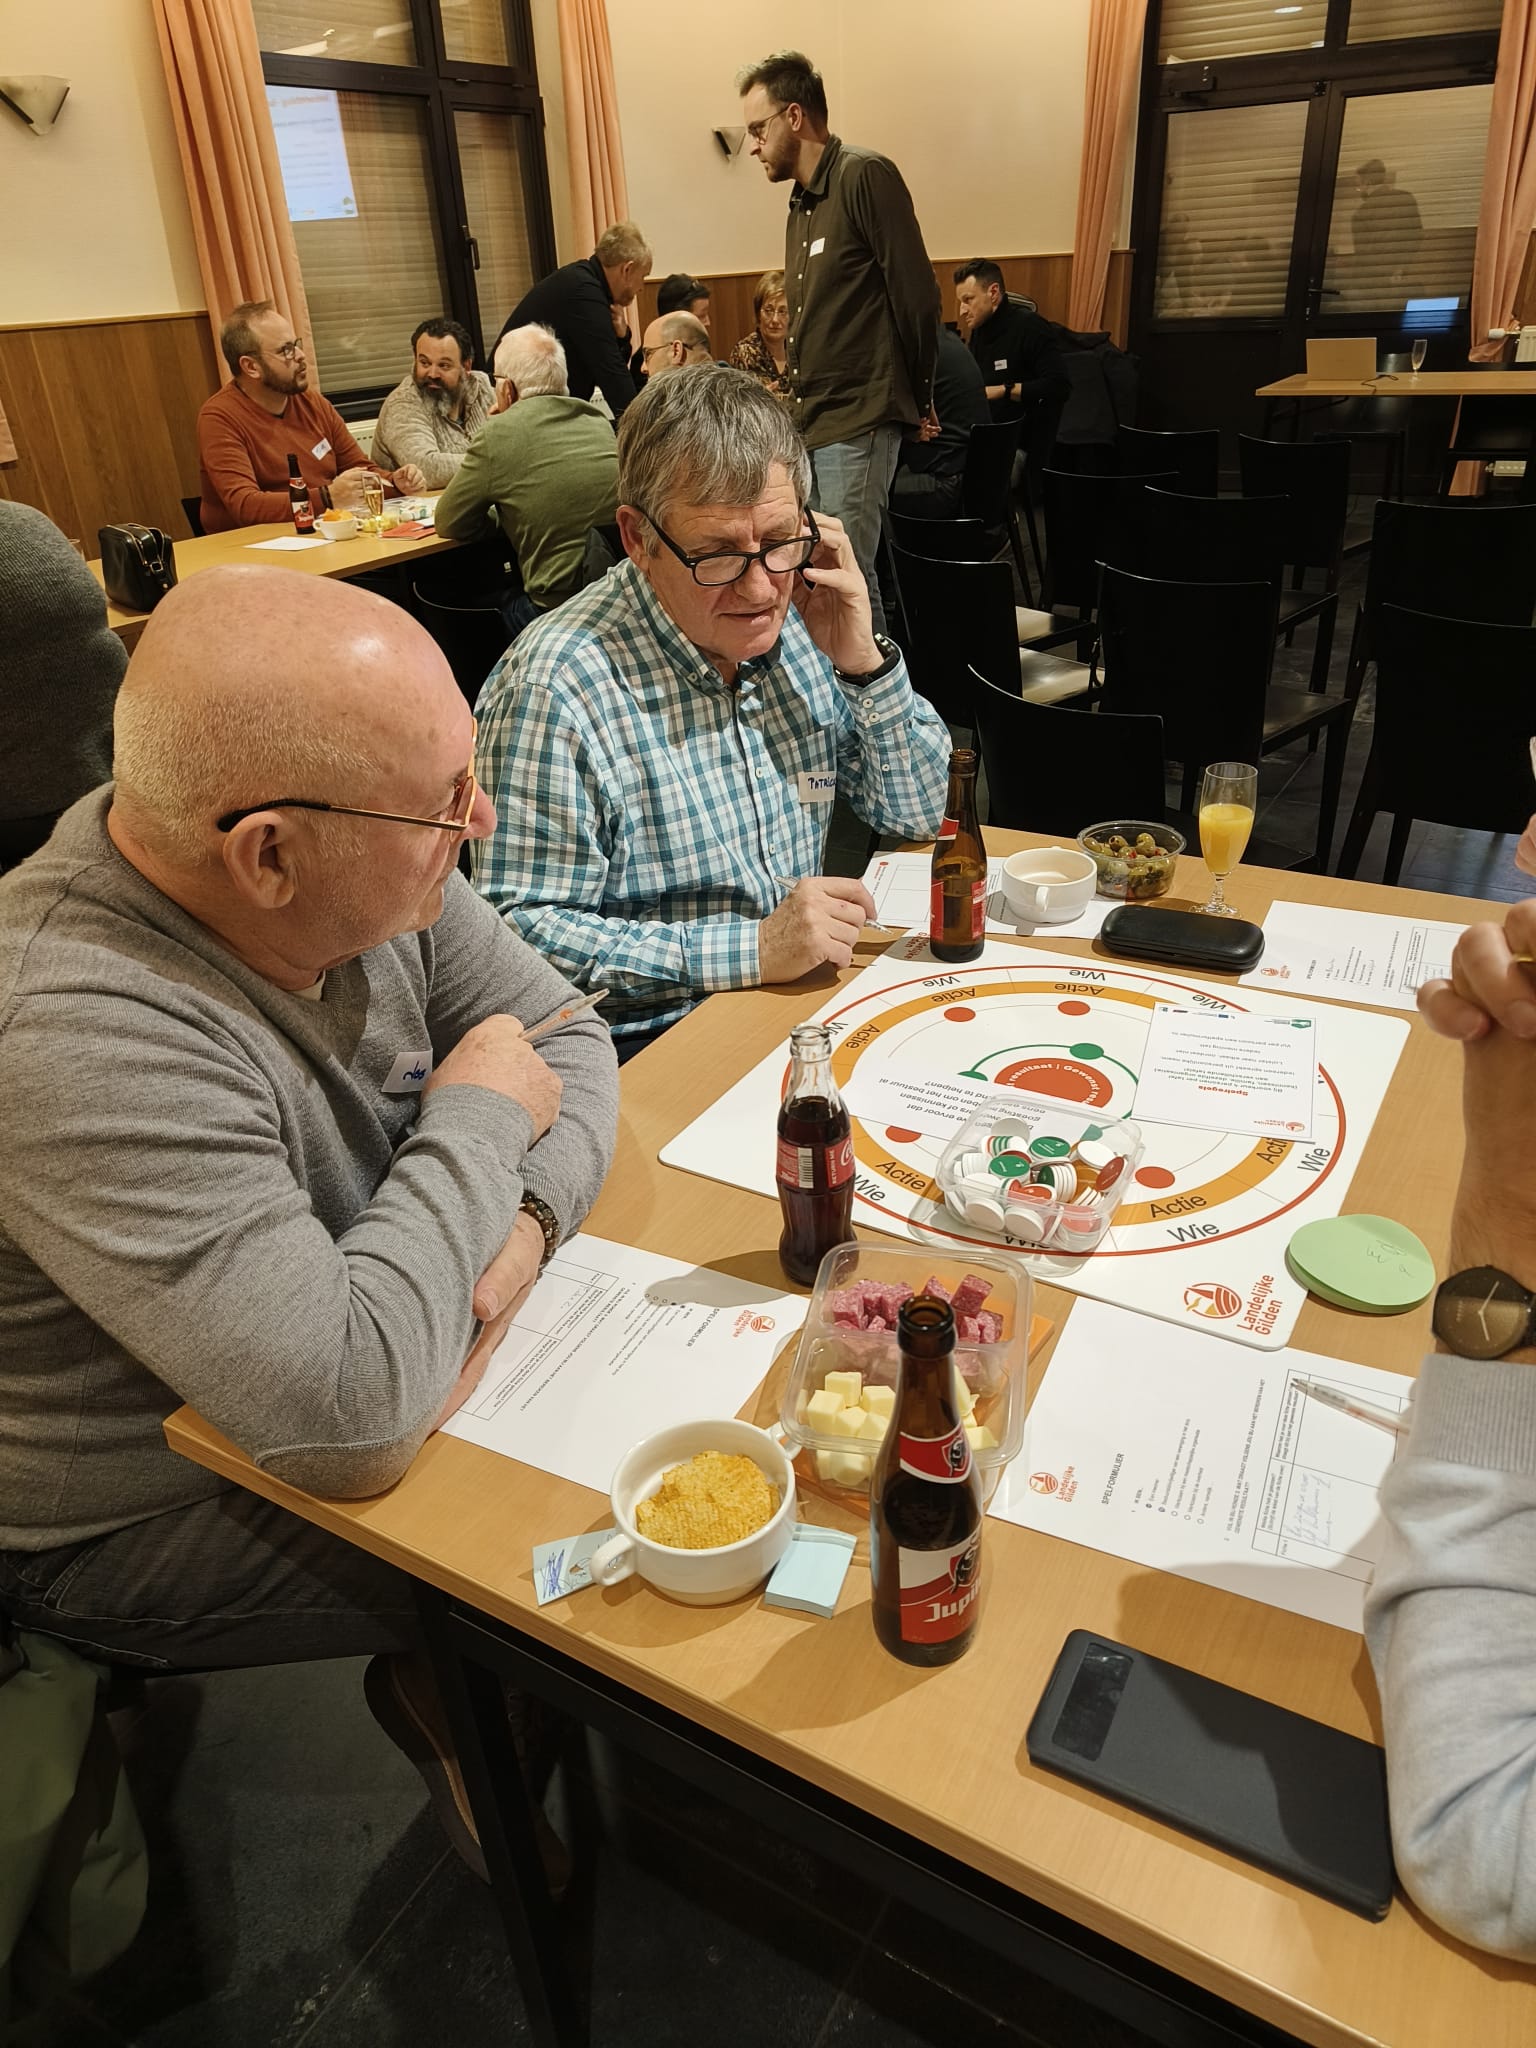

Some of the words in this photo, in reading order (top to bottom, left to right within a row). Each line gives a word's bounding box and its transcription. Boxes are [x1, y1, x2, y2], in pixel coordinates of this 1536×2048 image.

[922, 976, 961, 988] Wie
[1069, 969, 1106, 981] Wie
[931, 987, 976, 1003] Actie
[1055, 983, 1105, 996] Actie
[1192, 993, 1227, 1011] Wie
[846, 1024, 881, 1049] Actie
[888, 1080, 924, 1094] bestuur
[924, 1079, 962, 1094] helpen?
[925, 1089, 940, 1097] het
[1197, 1085, 1248, 1096] Spelregels
[899, 1092, 945, 1108] kennissen
[906, 1103, 922, 1112] dat
[924, 1108, 954, 1119] ervoor
[1256, 1137, 1288, 1165] Acti
[1297, 1147, 1331, 1172] Wie
[876, 1160, 927, 1191] Actie
[1150, 1195, 1207, 1218] Actie
[1167, 1222, 1220, 1242] Wie
[1237, 1275, 1275, 1331] Landelijke
[1255, 1300, 1283, 1335] Gilden
[1054, 1465, 1076, 1500] Landelijke
[1100, 1452, 1125, 1504] SPELFORMULIER
[1063, 1479, 1079, 1503] Gilden
